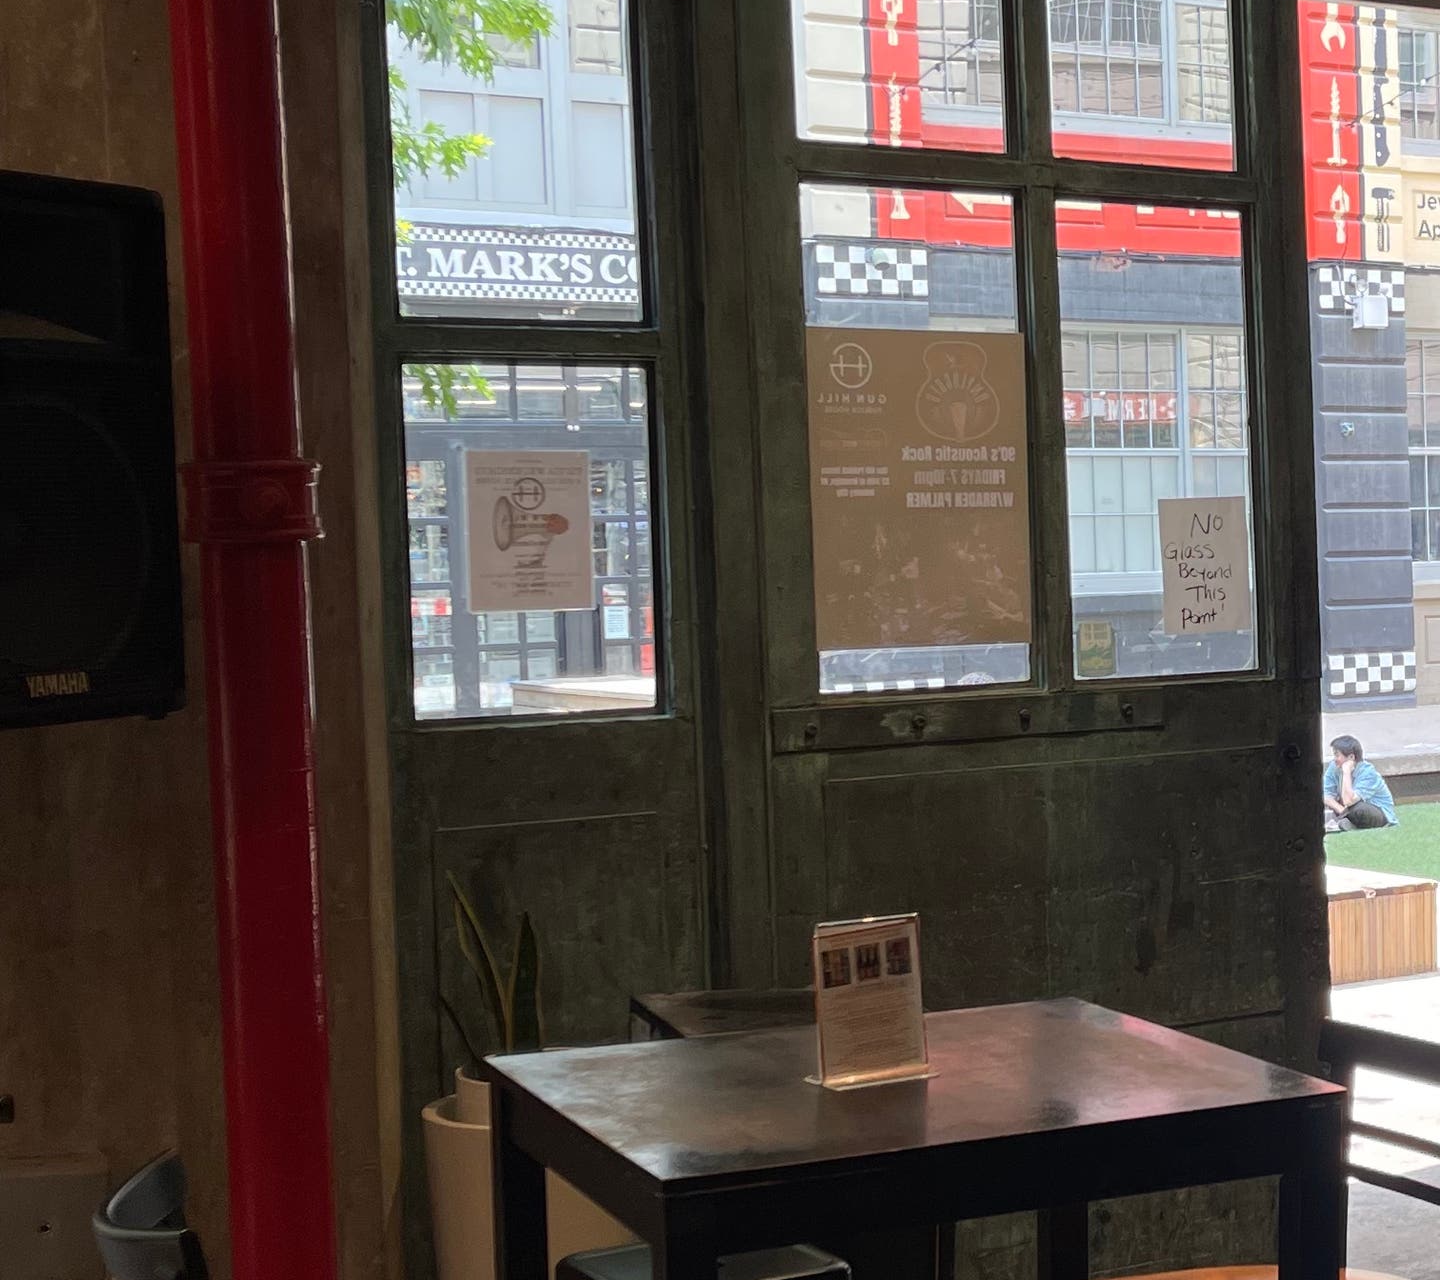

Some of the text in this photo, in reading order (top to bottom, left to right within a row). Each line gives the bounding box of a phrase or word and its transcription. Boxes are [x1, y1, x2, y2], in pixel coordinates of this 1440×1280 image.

[427, 247, 594, 284] MARK'S
[1191, 513, 1223, 538] NO
[1164, 542, 1215, 561] Glass
[1178, 562, 1232, 580] Beyond
[1185, 584, 1226, 602] This
[26, 671, 89, 698] YAMAHA
